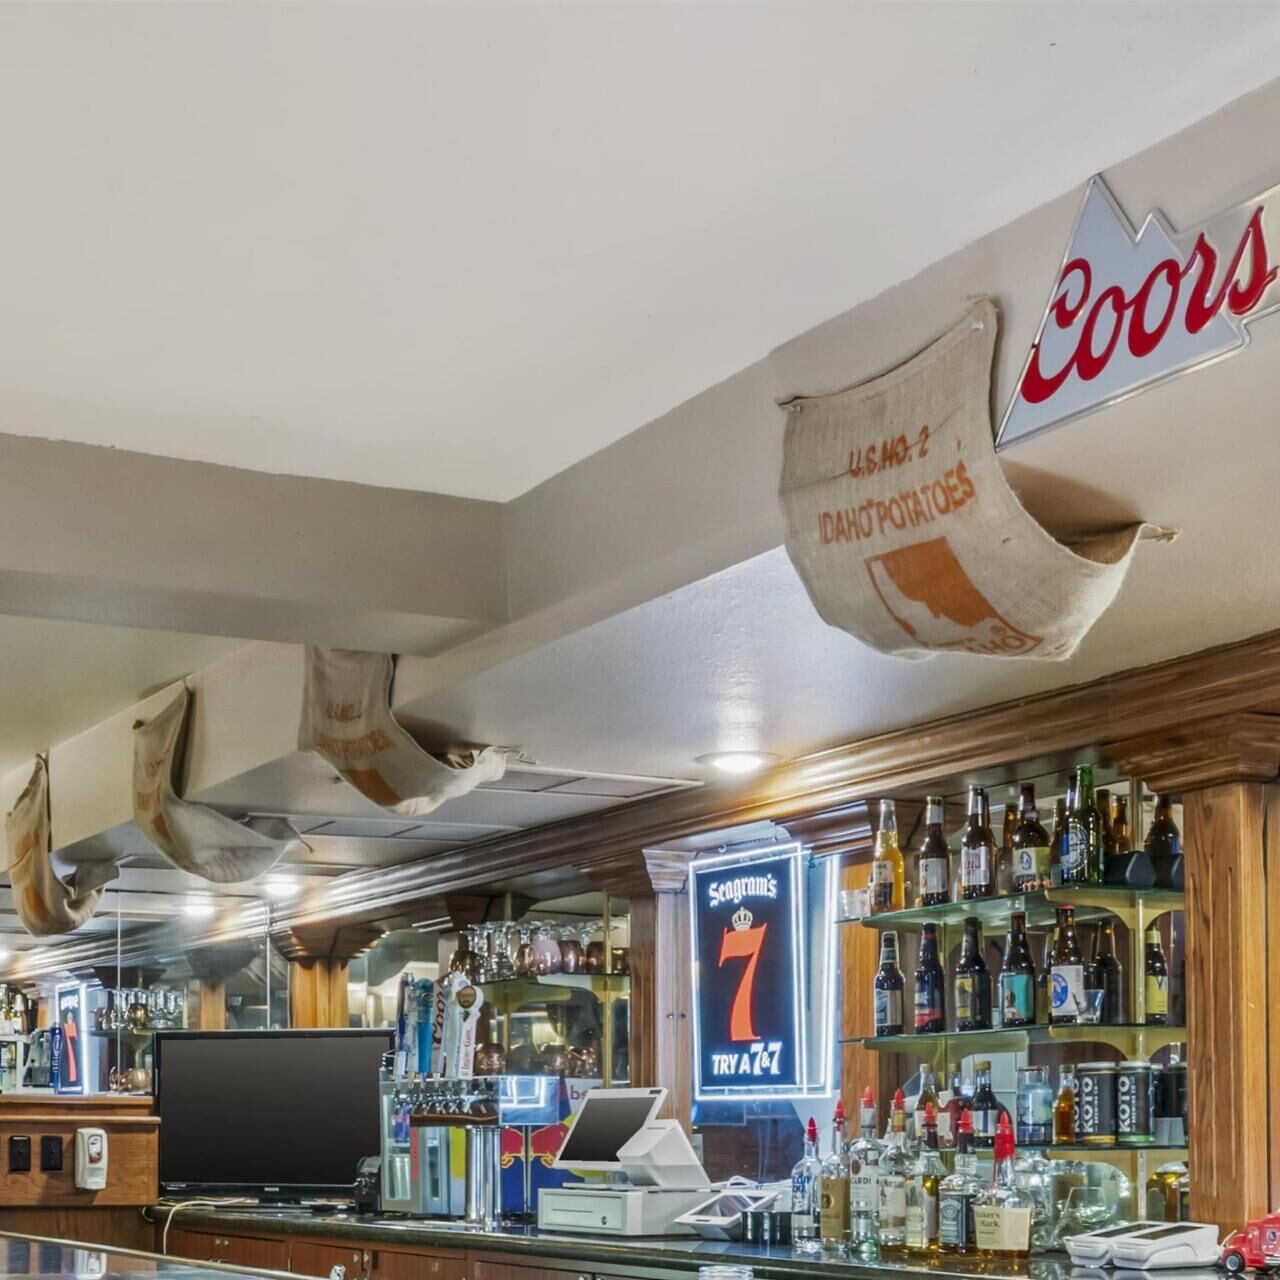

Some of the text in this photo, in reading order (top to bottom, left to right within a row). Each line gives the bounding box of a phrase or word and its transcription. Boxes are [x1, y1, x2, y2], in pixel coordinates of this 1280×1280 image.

[1020, 206, 1279, 403] Coors
[918, 425, 929, 458] 2
[877, 460, 976, 535] POTATOES
[709, 872, 777, 907] Seagram's
[718, 923, 768, 1041] 7
[712, 1042, 783, 1075] TRY A 7&7
[1082, 1077, 1094, 1132] KOTO
[1119, 1076, 1131, 1132] KOTO
